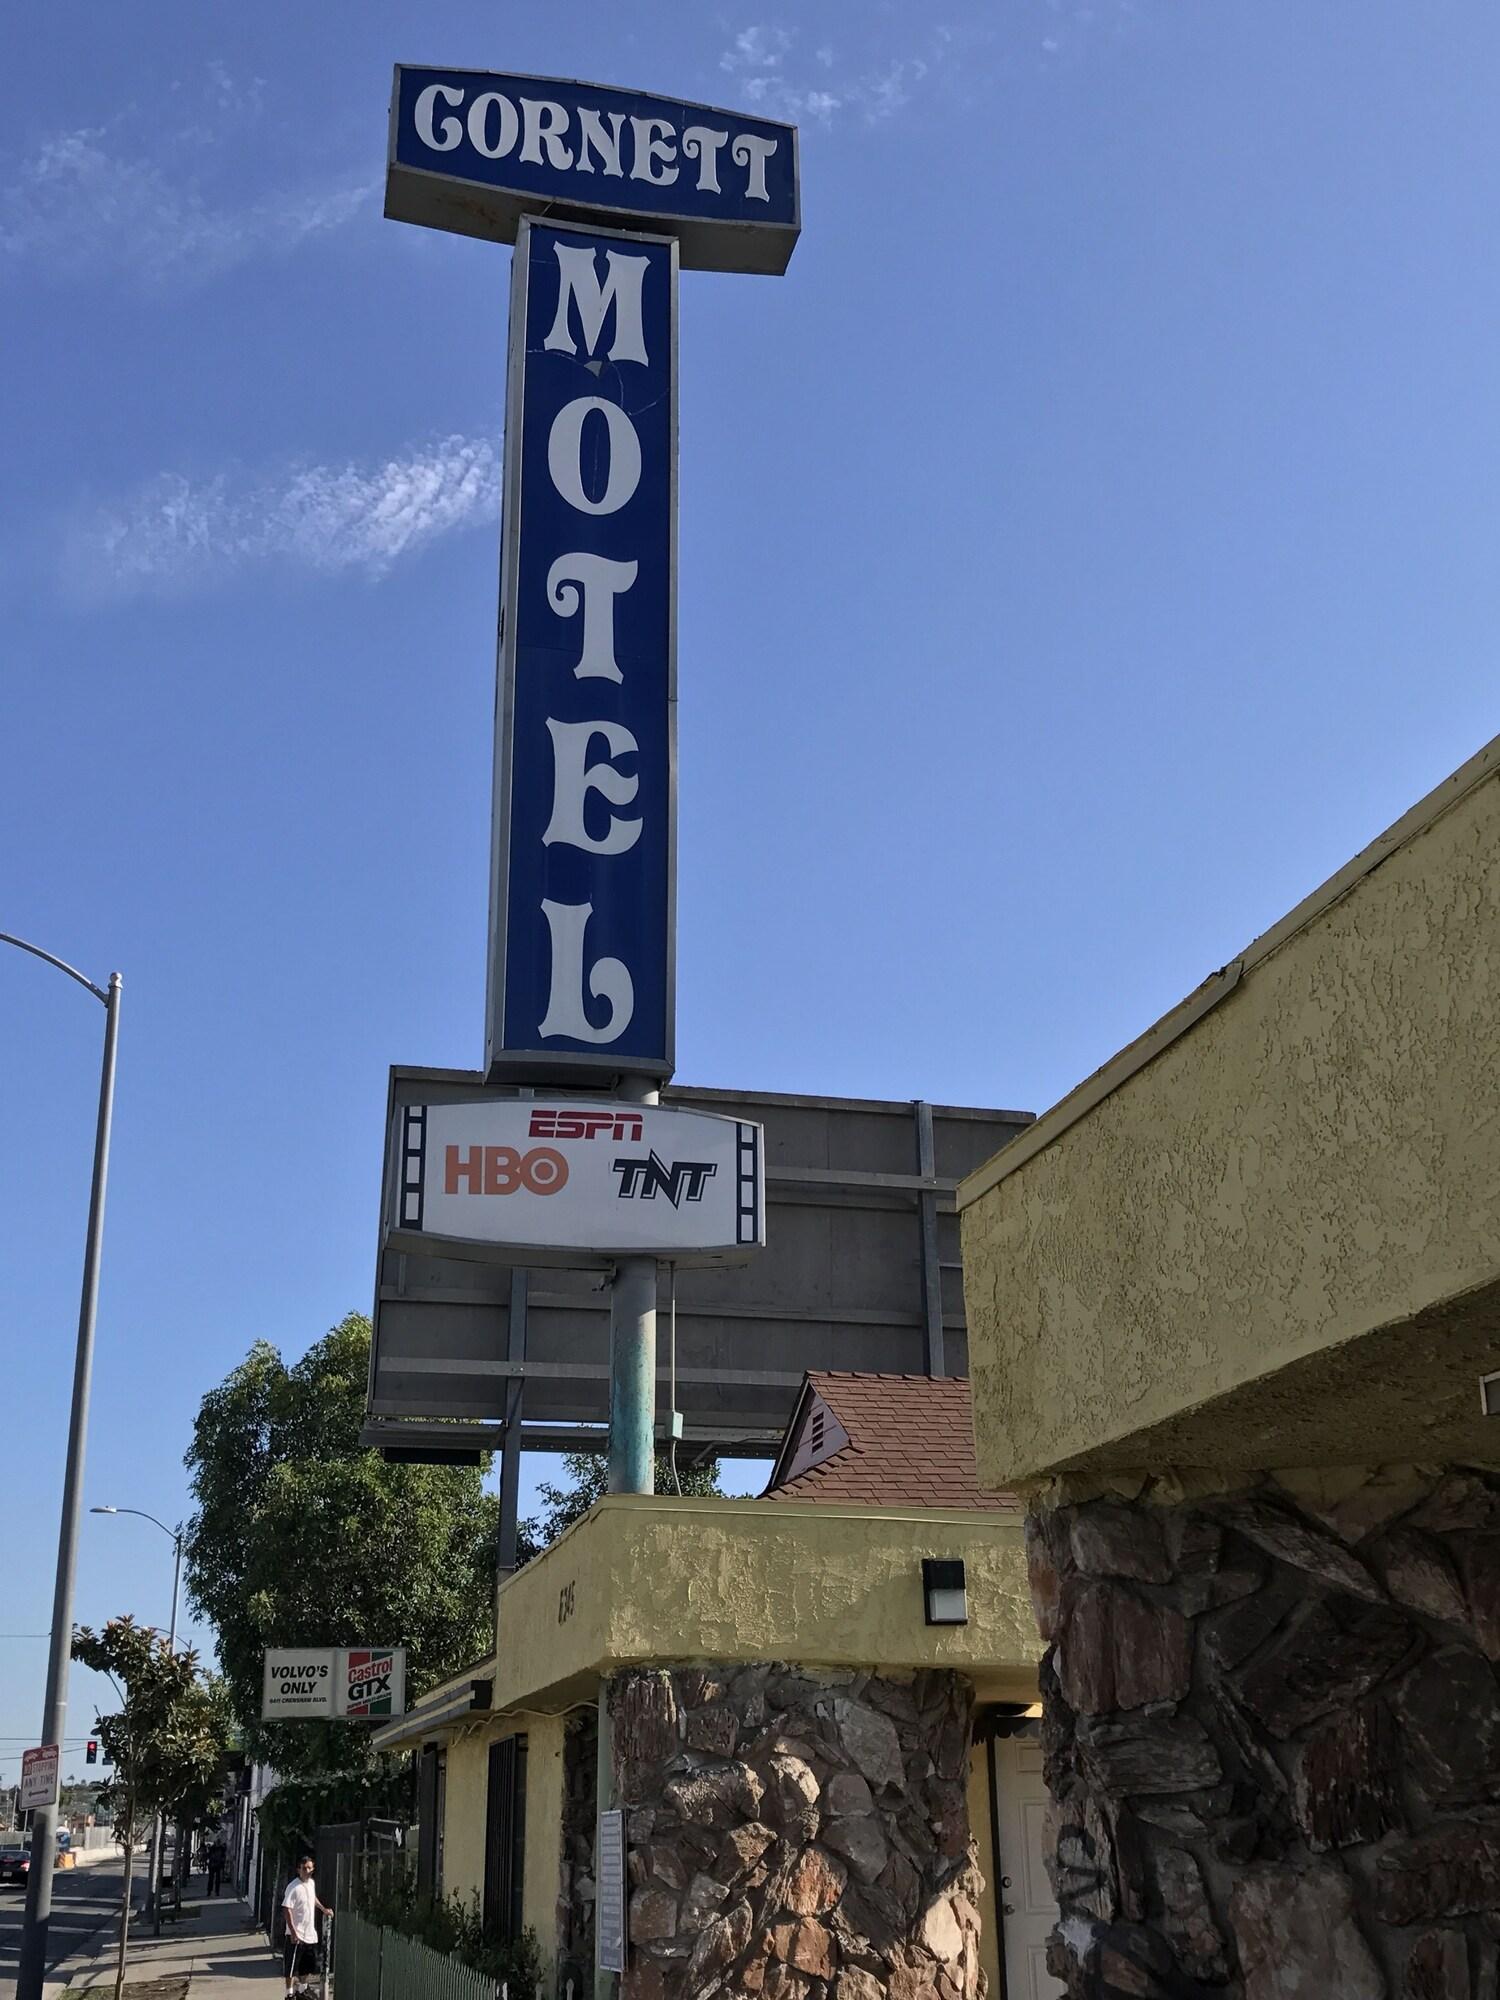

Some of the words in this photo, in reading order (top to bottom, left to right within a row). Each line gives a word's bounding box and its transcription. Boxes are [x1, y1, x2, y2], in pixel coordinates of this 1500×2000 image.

[414, 84, 778, 202] CORNETT
[536, 239, 652, 1044] MOTEL
[528, 1110, 643, 1141] ESPN
[444, 1145, 569, 1196] HBO
[612, 1148, 718, 1210] TNT
[271, 1665, 328, 1679] VOLVO'S
[347, 1656, 393, 1684] Castrol
[280, 1682, 317, 1695] ONLY
[348, 1673, 391, 1701] GTX
[24, 1776, 37, 1788] ANY
[40, 1773, 54, 1785] TIME
